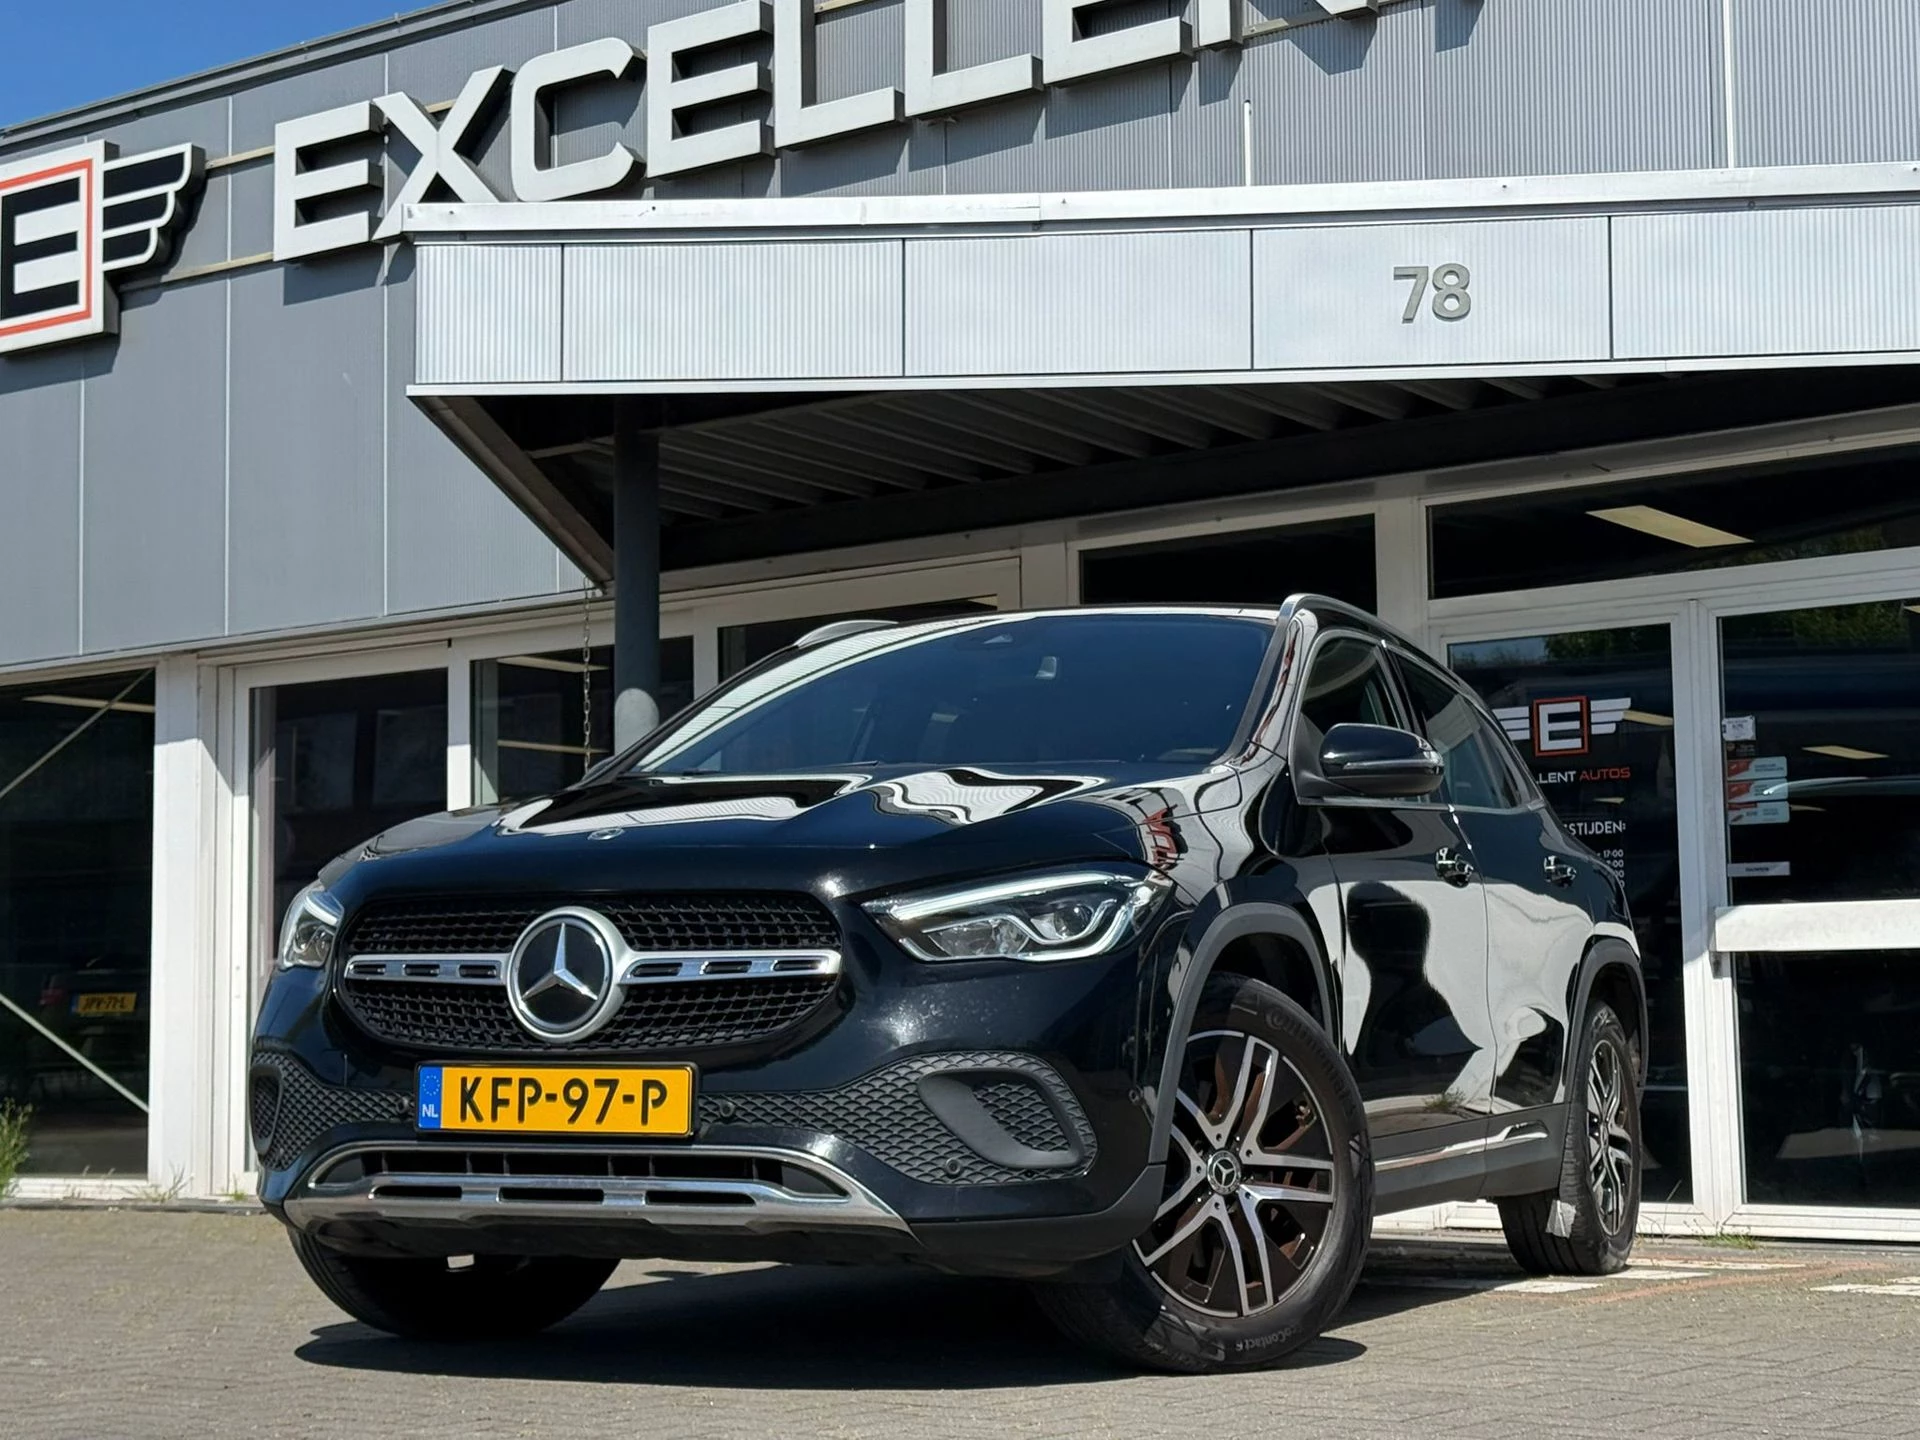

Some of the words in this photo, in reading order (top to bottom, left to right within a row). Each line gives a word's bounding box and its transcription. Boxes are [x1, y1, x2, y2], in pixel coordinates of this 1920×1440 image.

[1393, 263, 1472, 324] 78
[1538, 701, 1583, 751] E
[1536, 770, 1577, 784] LENT
[1579, 767, 1631, 781] AUTOS
[1564, 820, 1627, 836] STIJDEN:
[421, 1103, 439, 1119] NL
[459, 1076, 668, 1127] KFP-97-P
